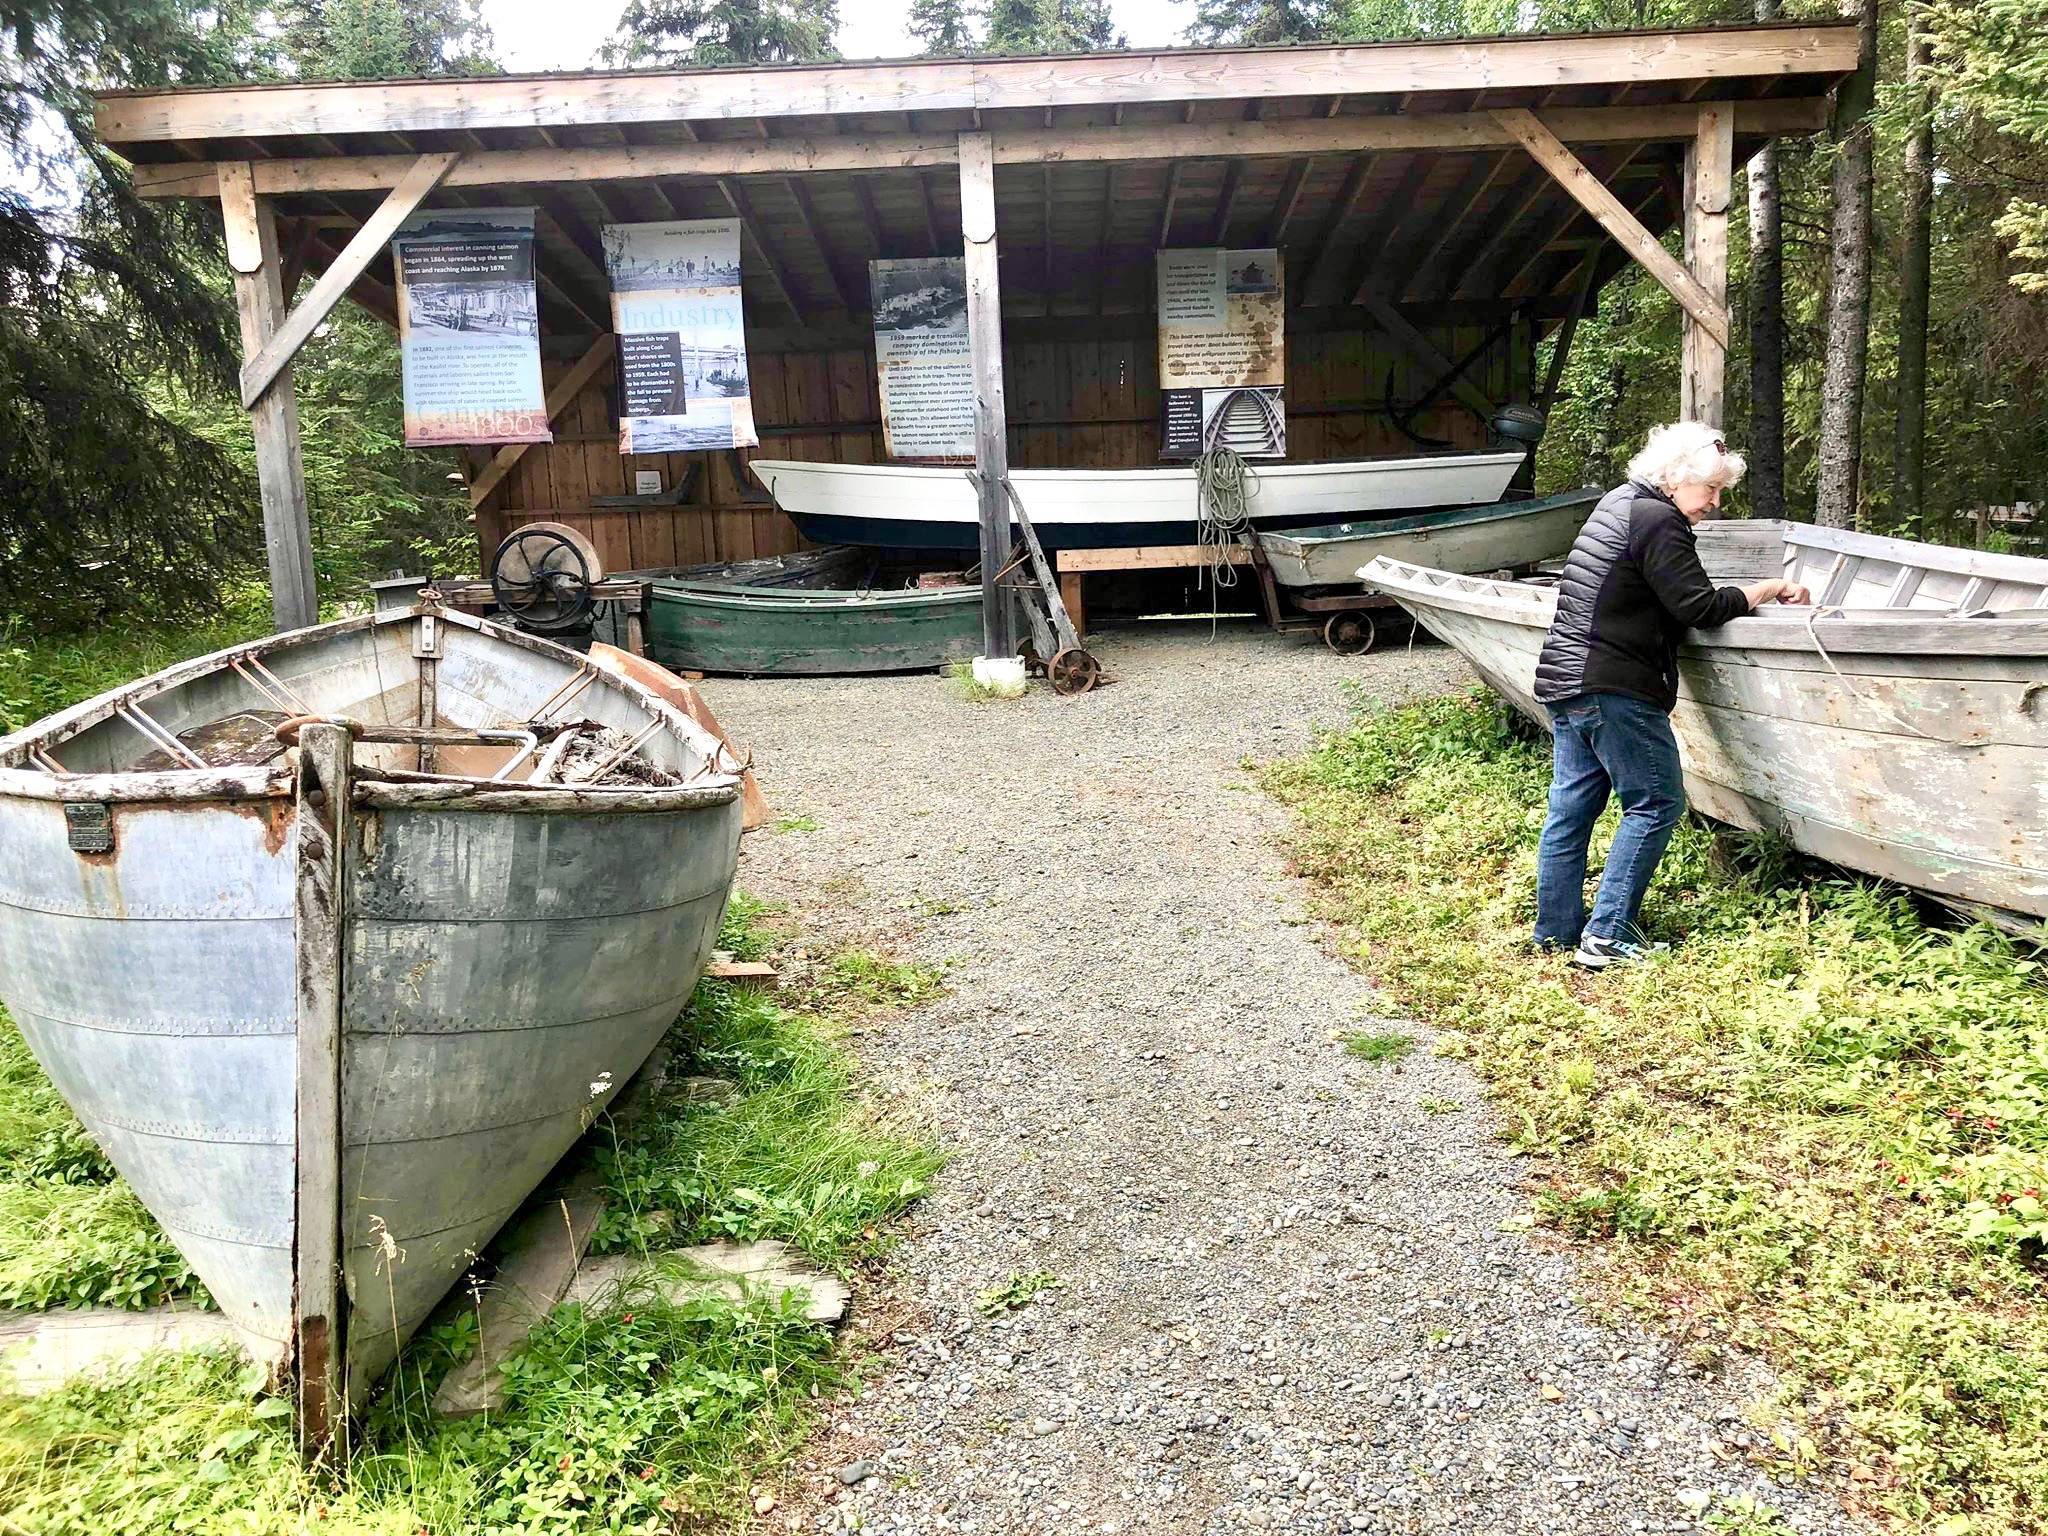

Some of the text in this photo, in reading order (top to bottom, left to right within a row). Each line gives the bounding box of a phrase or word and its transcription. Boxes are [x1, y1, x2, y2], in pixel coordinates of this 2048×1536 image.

[472, 244, 496, 252] canning
[405, 257, 422, 265] began
[448, 255, 477, 263] spreading
[434, 267, 460, 275] reaching
[624, 302, 739, 330] Industry
[1168, 351, 1184, 359] period
[652, 388, 672, 396] prevent
[628, 397, 648, 405] damage
